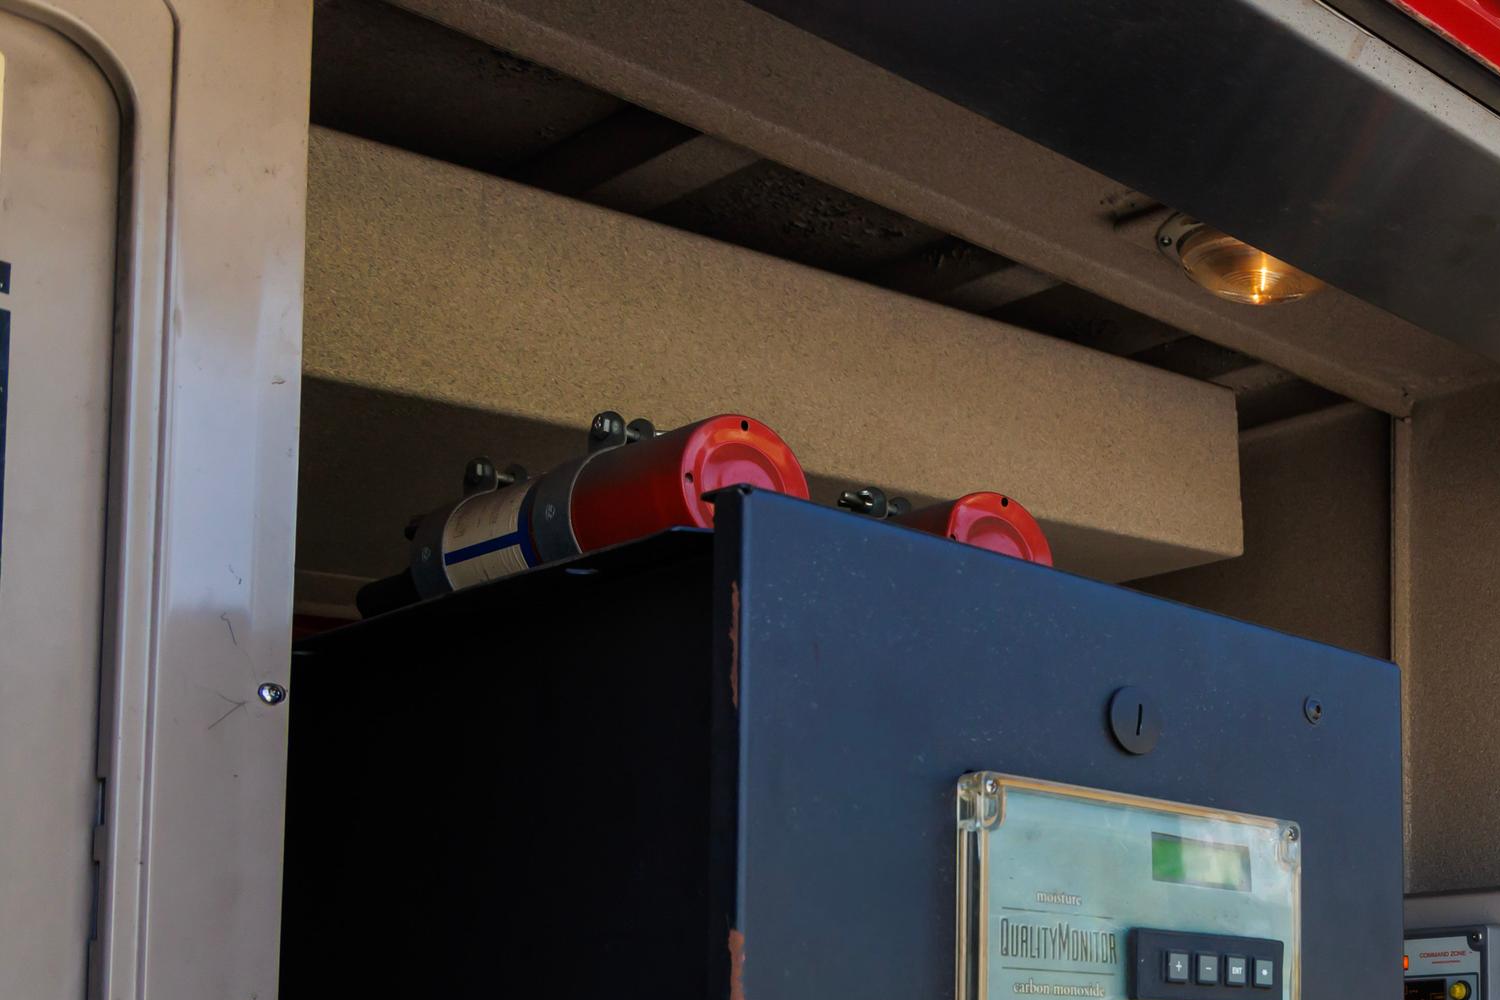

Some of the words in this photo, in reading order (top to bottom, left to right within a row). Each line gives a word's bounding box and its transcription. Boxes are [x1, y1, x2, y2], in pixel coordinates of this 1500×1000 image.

[1036, 891, 1082, 905] moisture
[1013, 977, 1051, 997] carbon
[1053, 983, 1105, 998] monoxide
